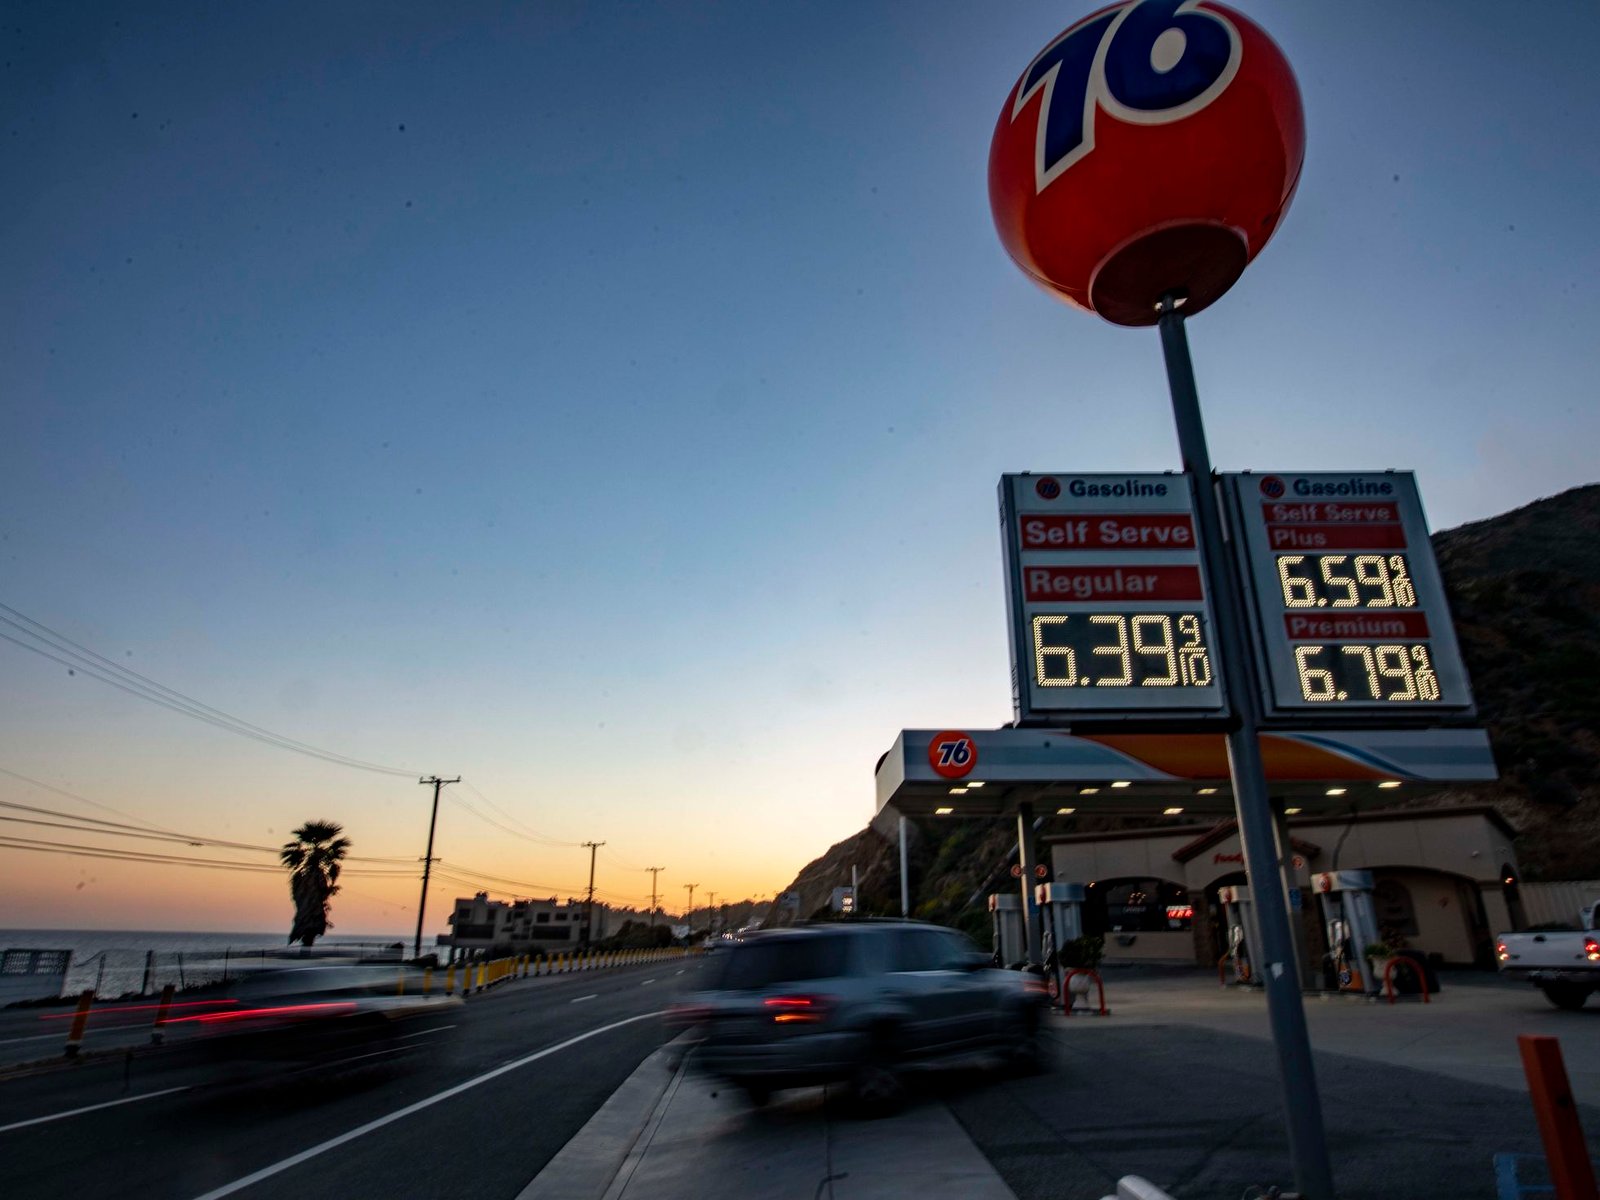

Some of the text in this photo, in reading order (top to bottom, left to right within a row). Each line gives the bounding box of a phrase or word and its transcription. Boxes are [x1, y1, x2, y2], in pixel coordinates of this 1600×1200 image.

[1011, 0, 1242, 195] 76
[1069, 479, 1168, 497] Gasoline
[1293, 478, 1394, 496] Gasoline
[1272, 505, 1391, 521] Self Serve
[1025, 520, 1191, 544] Self Serve
[1273, 529, 1327, 546] Plus
[1029, 569, 1158, 597] Regular
[1277, 555, 1395, 608] 6.59
[1291, 617, 1407, 634] Premium
[1033, 615, 1178, 686] 6.39
[1295, 645, 1417, 701] 6.79
[937, 739, 971, 767] 76
